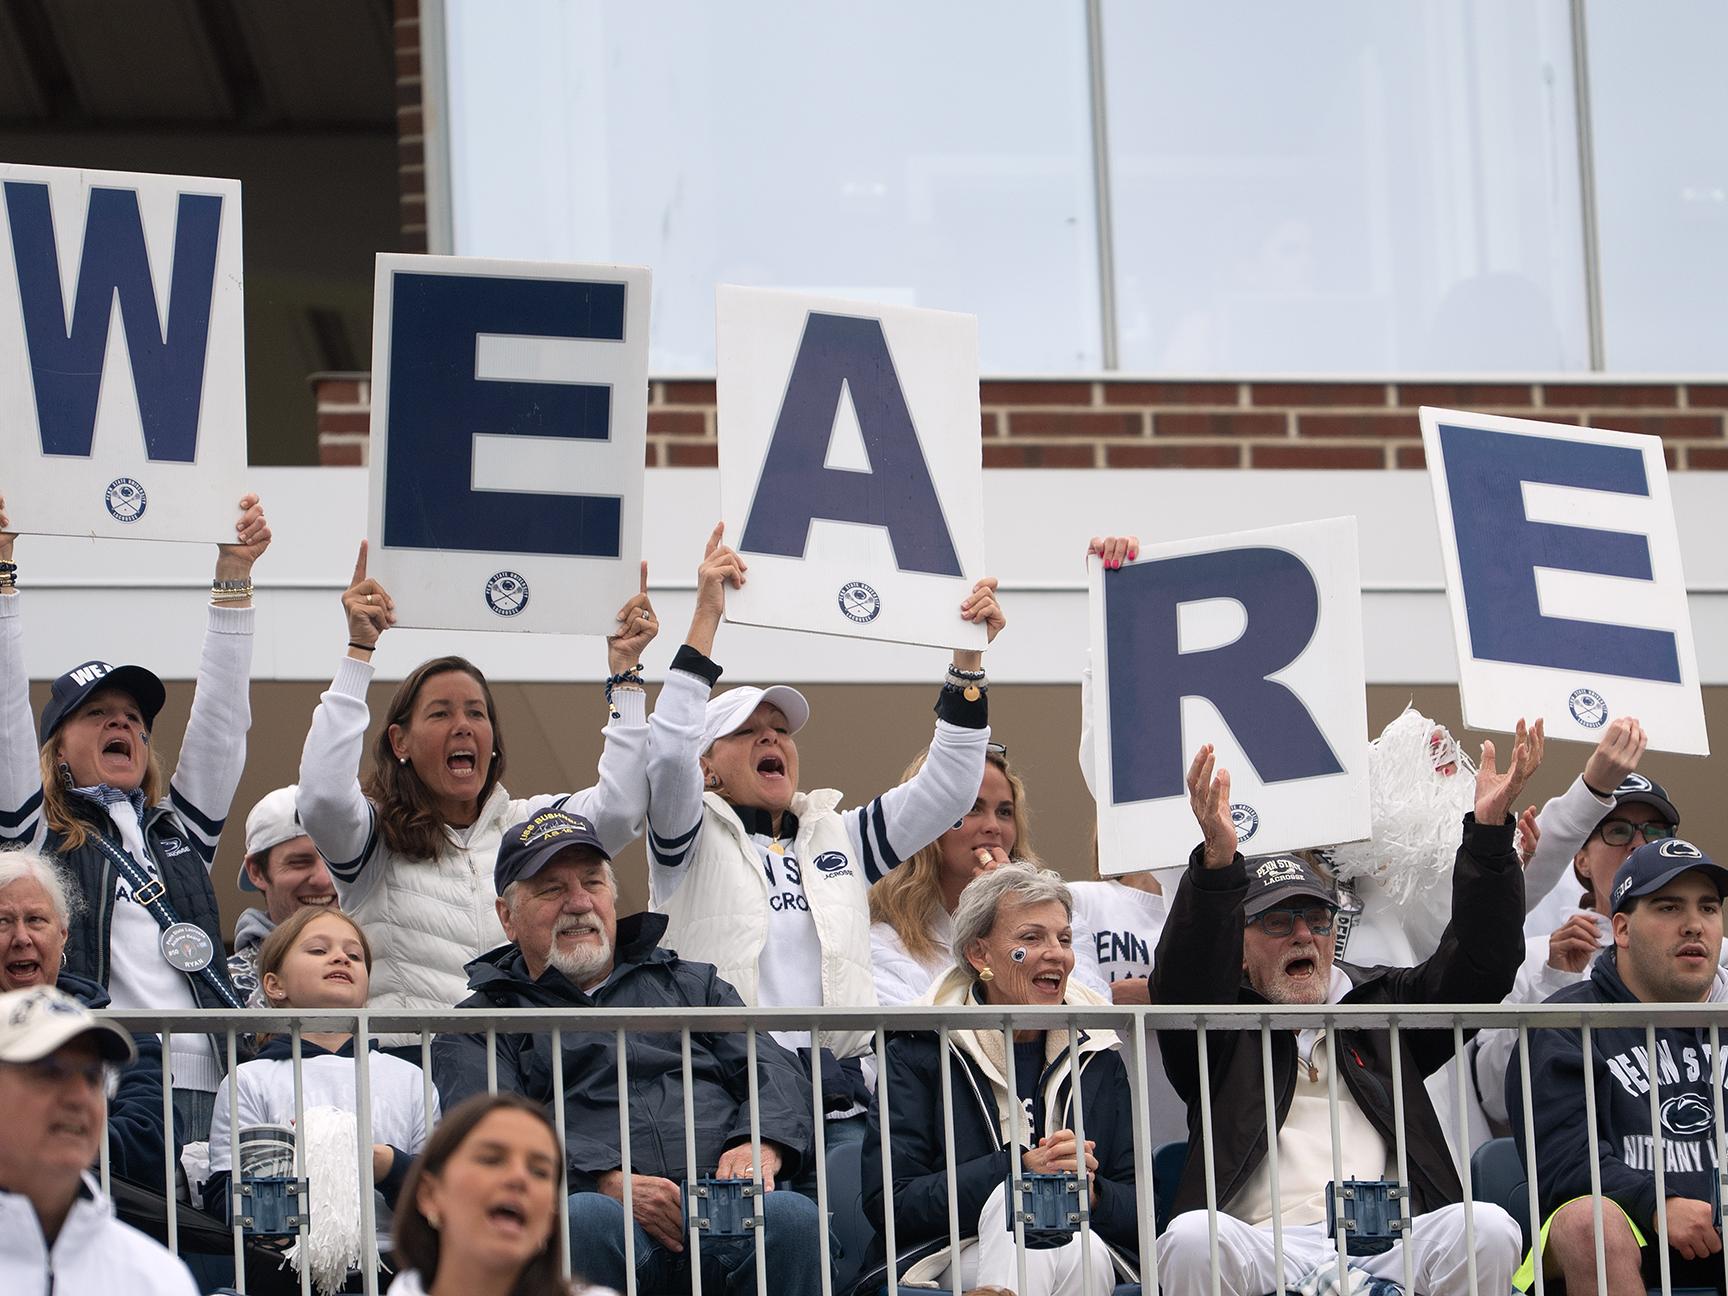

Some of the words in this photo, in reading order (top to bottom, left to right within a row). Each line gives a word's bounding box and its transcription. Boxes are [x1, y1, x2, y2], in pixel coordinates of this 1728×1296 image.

[3, 181, 224, 463] W
[381, 270, 628, 560] E
[736, 310, 967, 579] A
[1438, 423, 1684, 686] E
[69, 664, 106, 687] WE
[1102, 544, 1348, 807] R
[519, 824, 535, 841] USS
[1256, 860, 1278, 878] PENN
[1276, 859, 1304, 873] STATE
[1263, 874, 1306, 887] LACROSSE
[184, 958, 205, 968] RYAN
[1092, 930, 1150, 965] ENN
